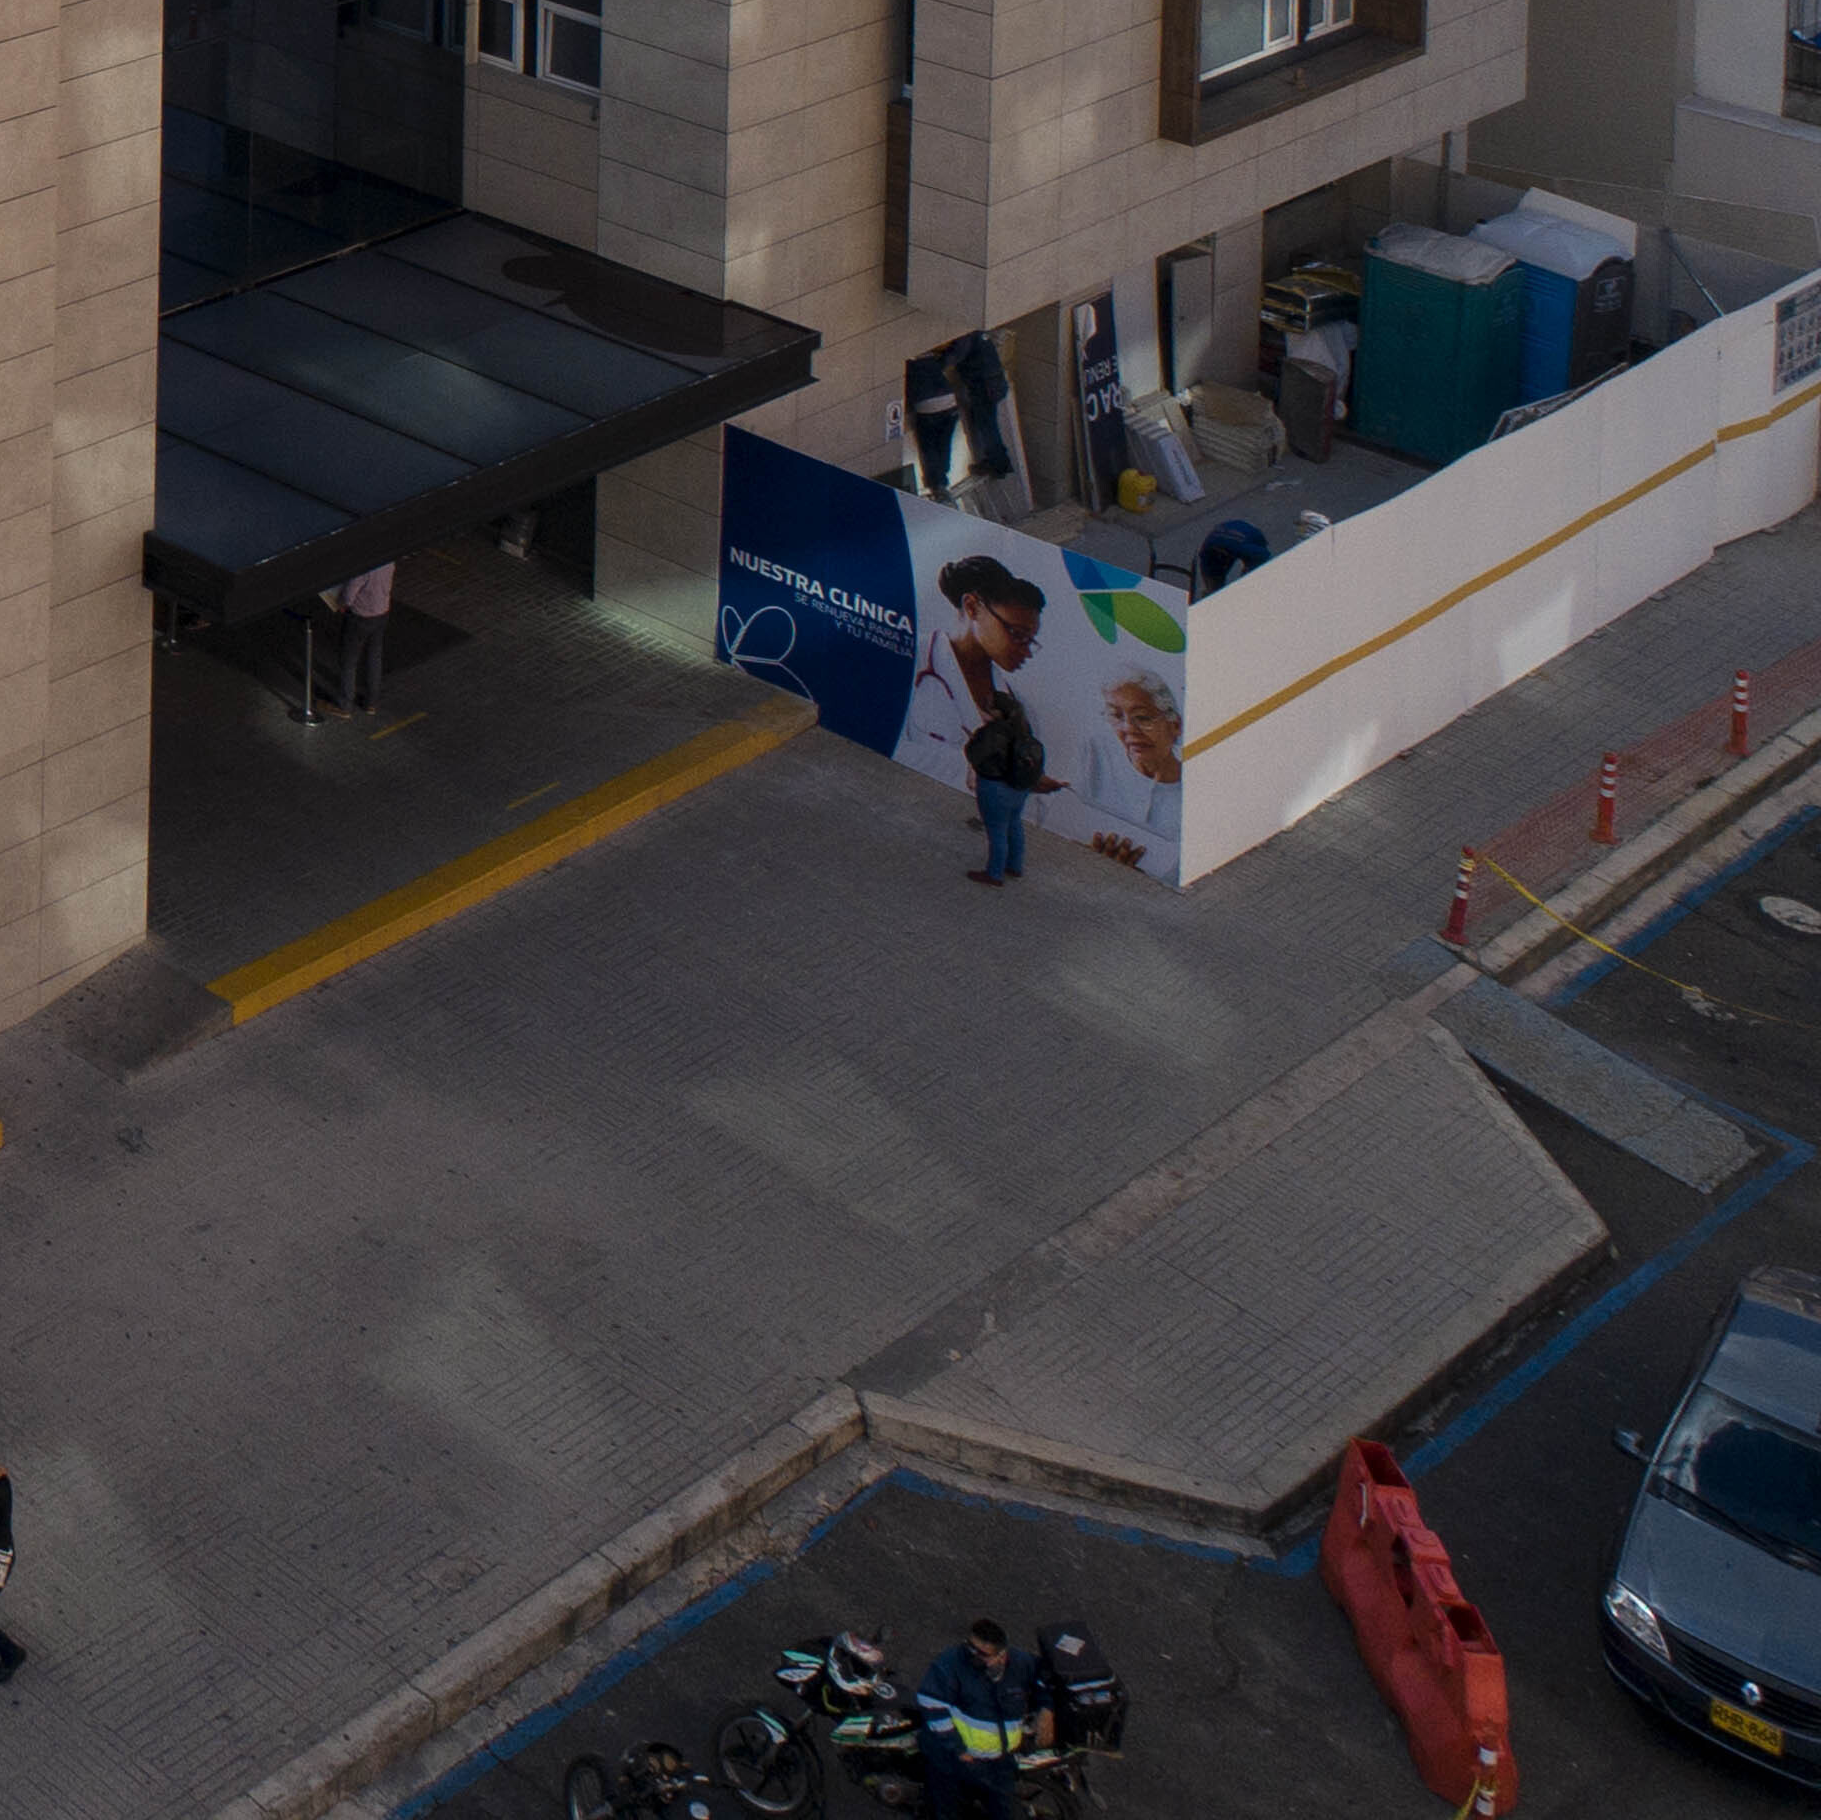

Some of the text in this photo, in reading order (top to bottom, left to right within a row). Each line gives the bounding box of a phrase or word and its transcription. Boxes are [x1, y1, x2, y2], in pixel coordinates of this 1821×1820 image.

[729, 546, 913, 635] NUESTRA CLÍNICA
[794, 592, 808, 606] SE
[812, 598, 865, 629] RENUEVA
[869, 621, 900, 642] PARA
[834, 618, 914, 659] Y TU FAMILIA
